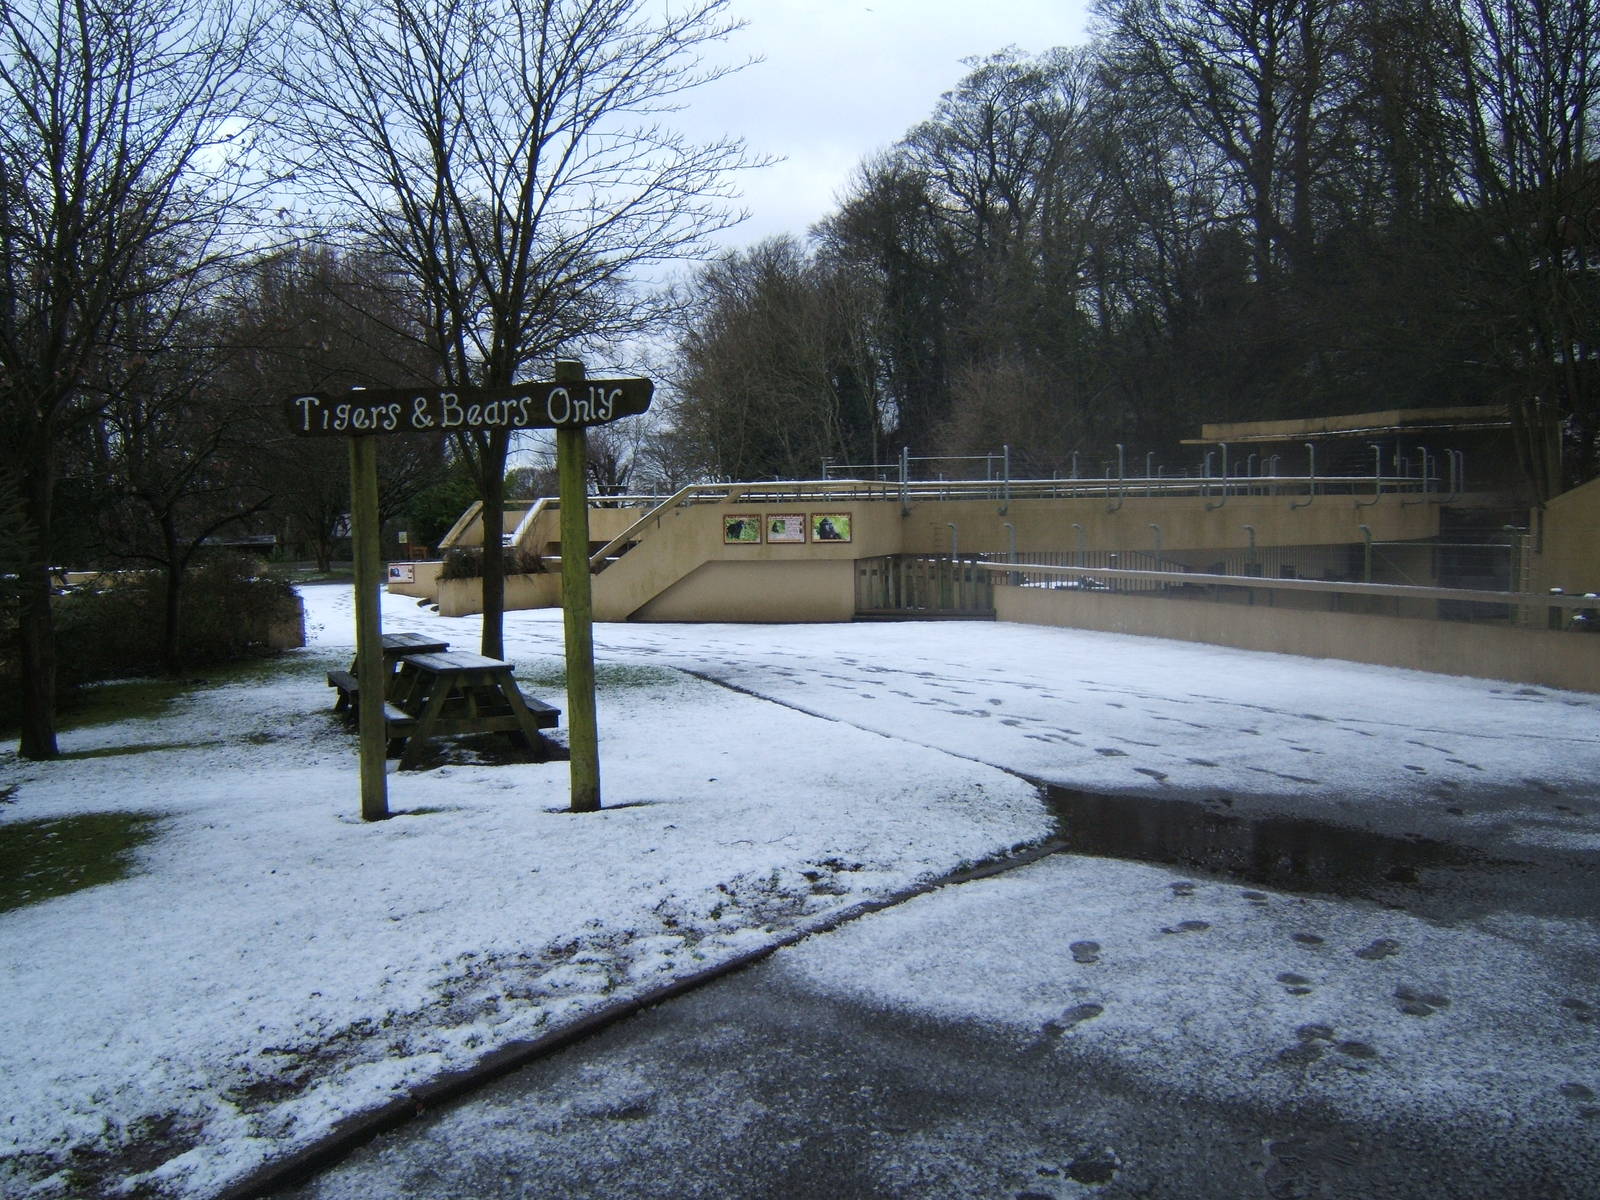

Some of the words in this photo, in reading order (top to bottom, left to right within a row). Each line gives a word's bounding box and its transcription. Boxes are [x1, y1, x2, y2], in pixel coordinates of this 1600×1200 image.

[295, 396, 402, 431] Tigers
[411, 397, 434, 430] &
[440, 392, 532, 429] Bears
[547, 386, 623, 424] Only
